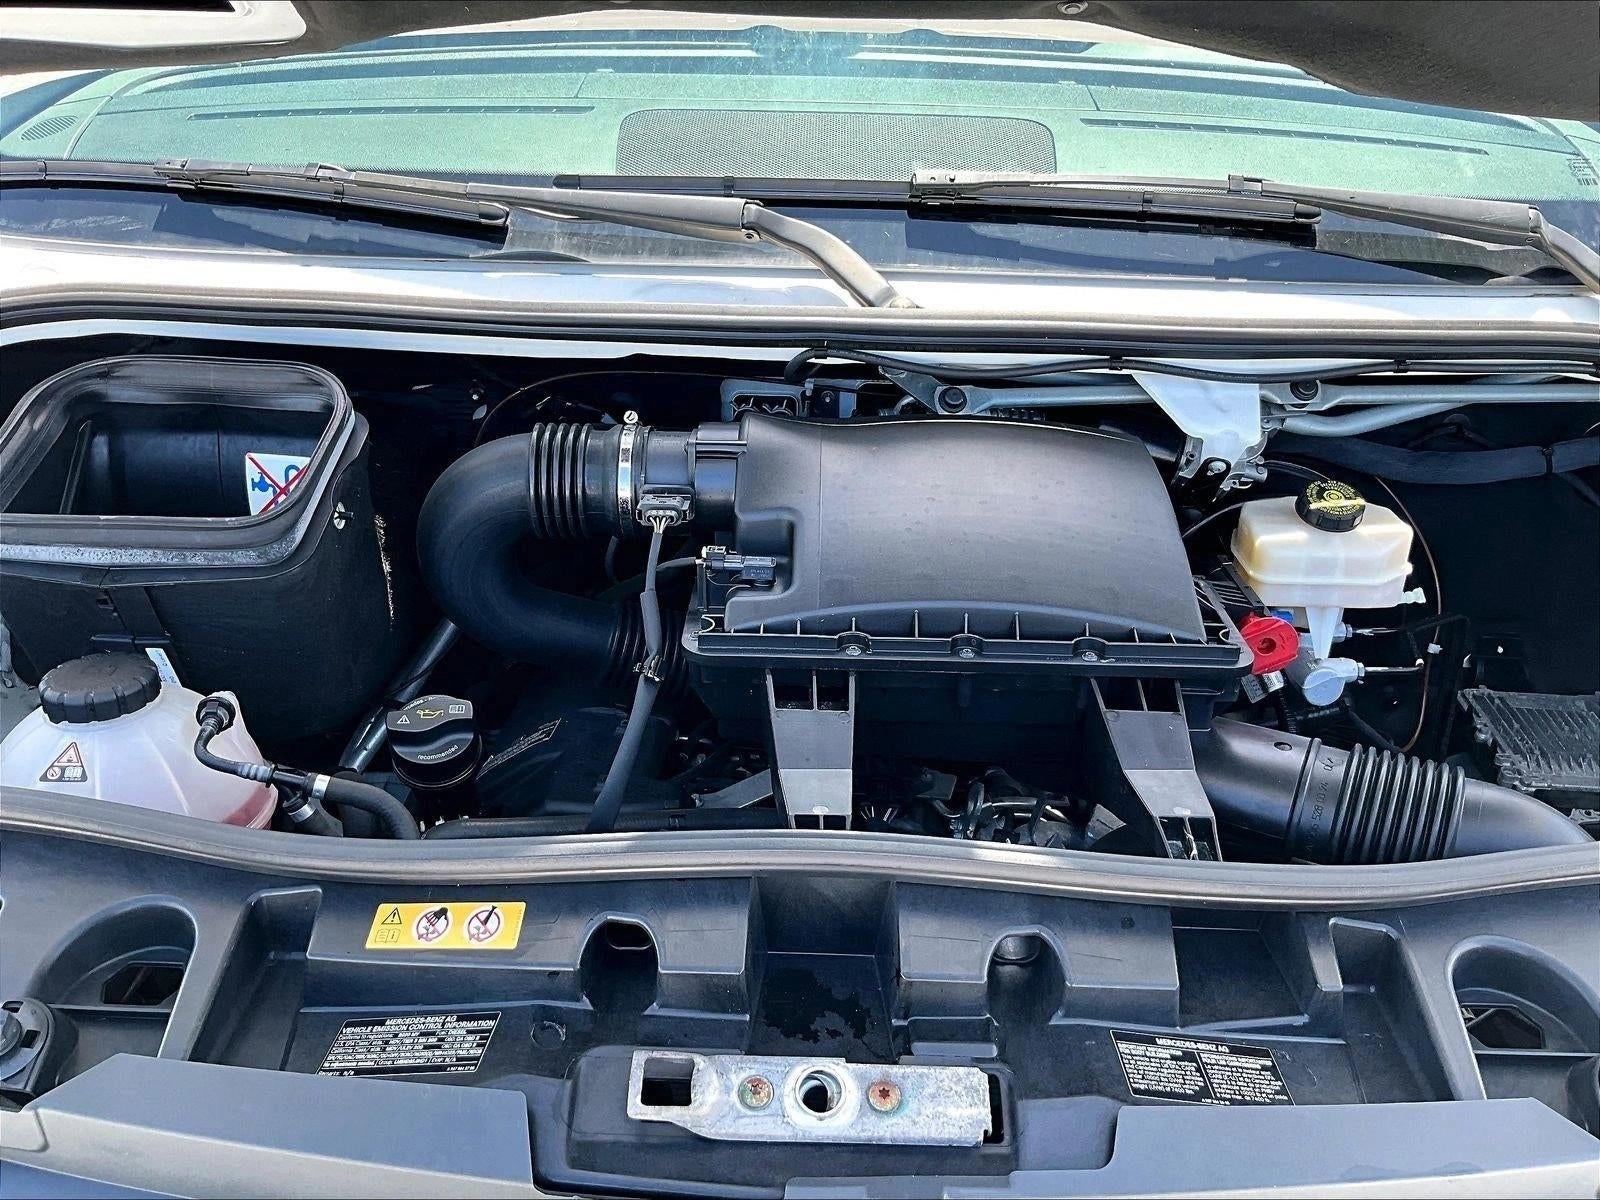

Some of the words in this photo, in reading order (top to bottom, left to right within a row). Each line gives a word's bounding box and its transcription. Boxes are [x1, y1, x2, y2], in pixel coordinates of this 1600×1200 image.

[417, 744, 459, 760] recommended
[385, 1017, 446, 1025] MERCEDES-BENZ
[444, 1020, 495, 1028] INFORMATION
[1156, 1038, 1218, 1051] MERCEDES-BENZ
